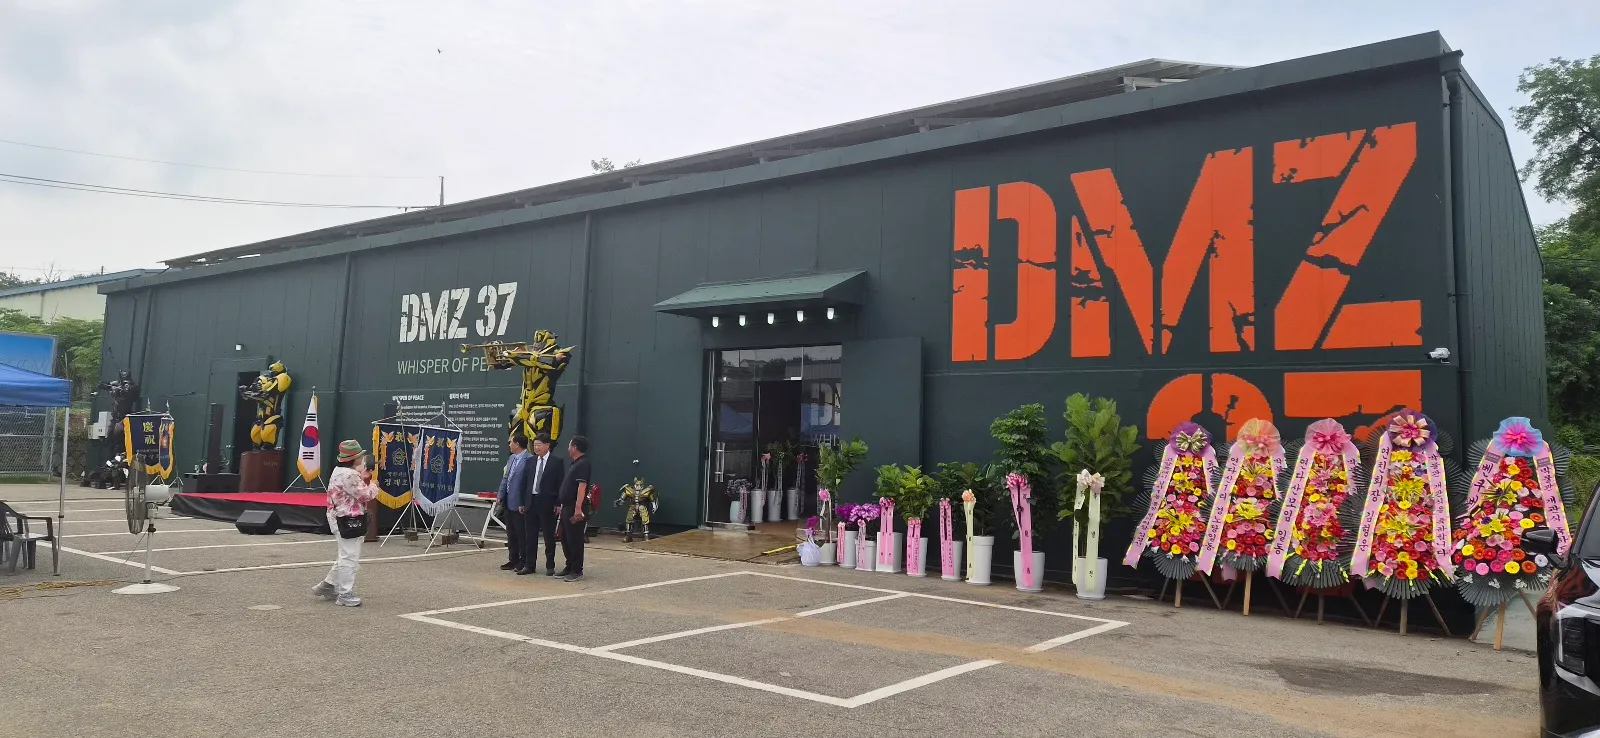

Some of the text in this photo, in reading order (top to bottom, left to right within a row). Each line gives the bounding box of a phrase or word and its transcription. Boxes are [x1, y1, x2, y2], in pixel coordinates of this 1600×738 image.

[951, 122, 1423, 362] DMZ
[399, 281, 518, 343] DMZ 37
[397, 358, 449, 375] WHISPER
[451, 357, 469, 372] OF
